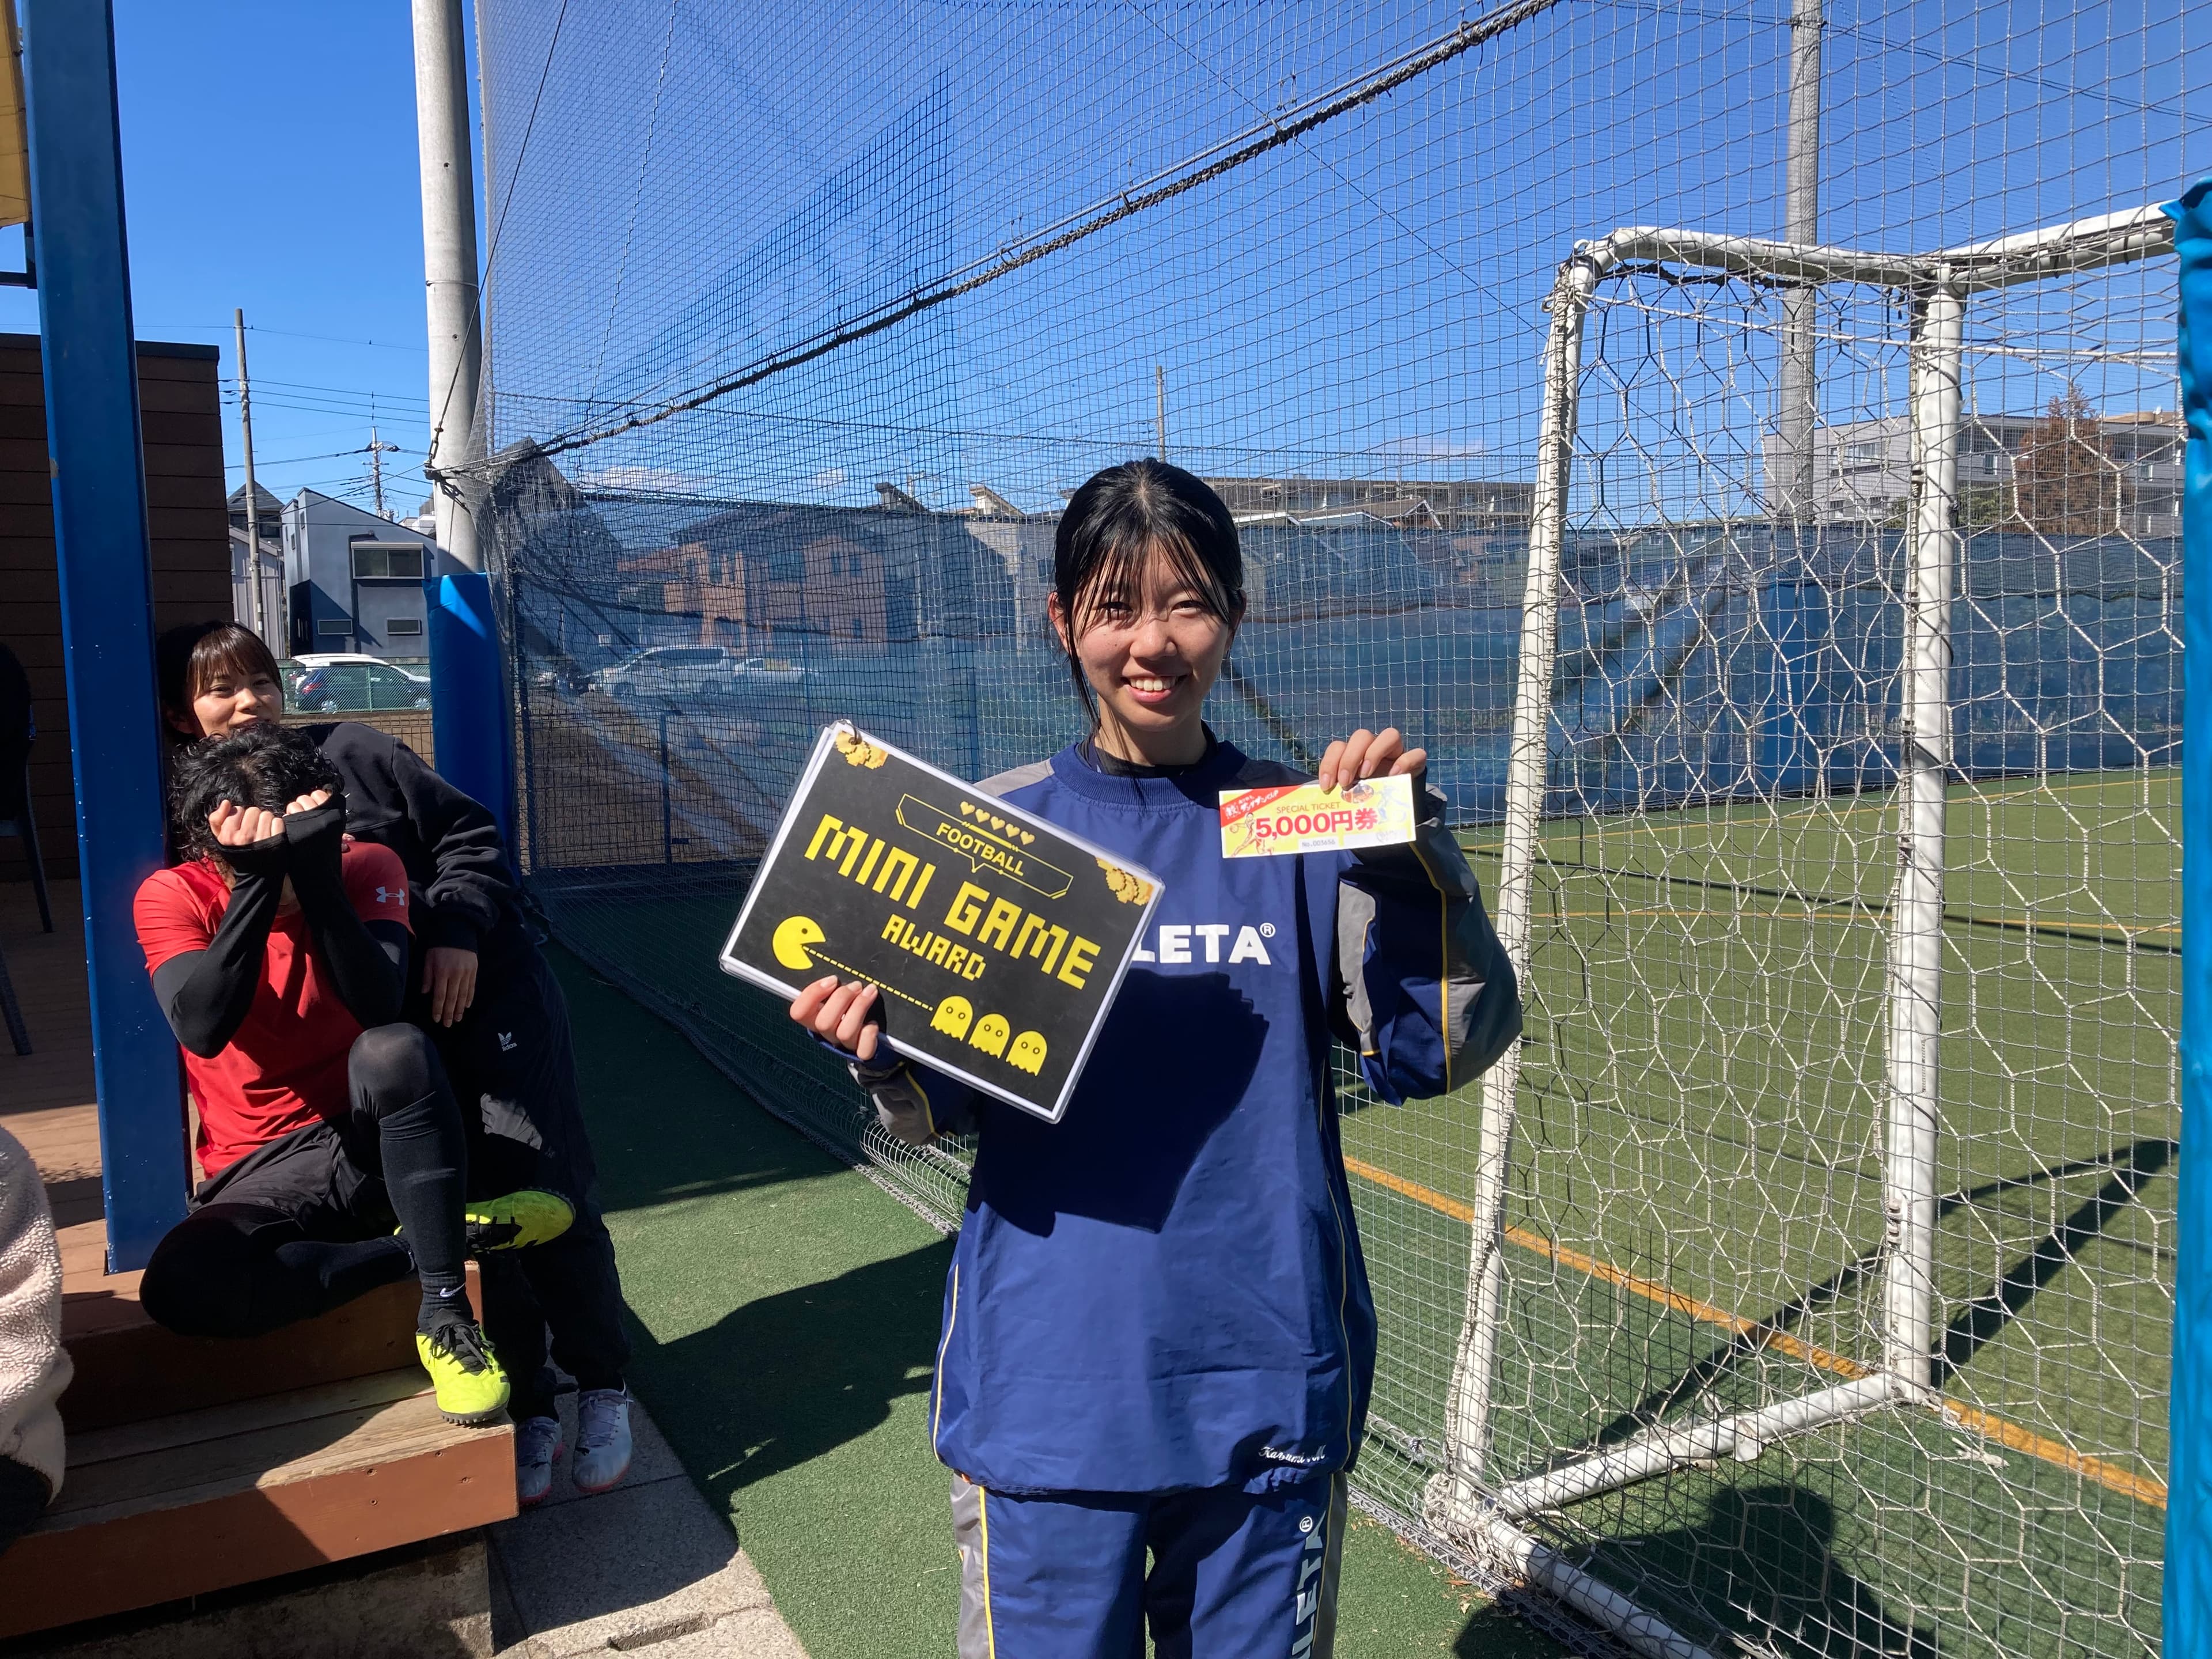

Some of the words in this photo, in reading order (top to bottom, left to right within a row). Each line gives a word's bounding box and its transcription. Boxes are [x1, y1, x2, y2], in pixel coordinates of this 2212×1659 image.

[1256, 808, 1378, 840] 5,000円券
[1276, 804, 1309, 814] SPECIAL
[1310, 801, 1341, 812] TICKET
[935, 821, 1024, 877] FOOTBALL
[804, 813, 936, 910] MINI
[943, 880, 1101, 990] GAME
[881, 914, 987, 982] AWARD
